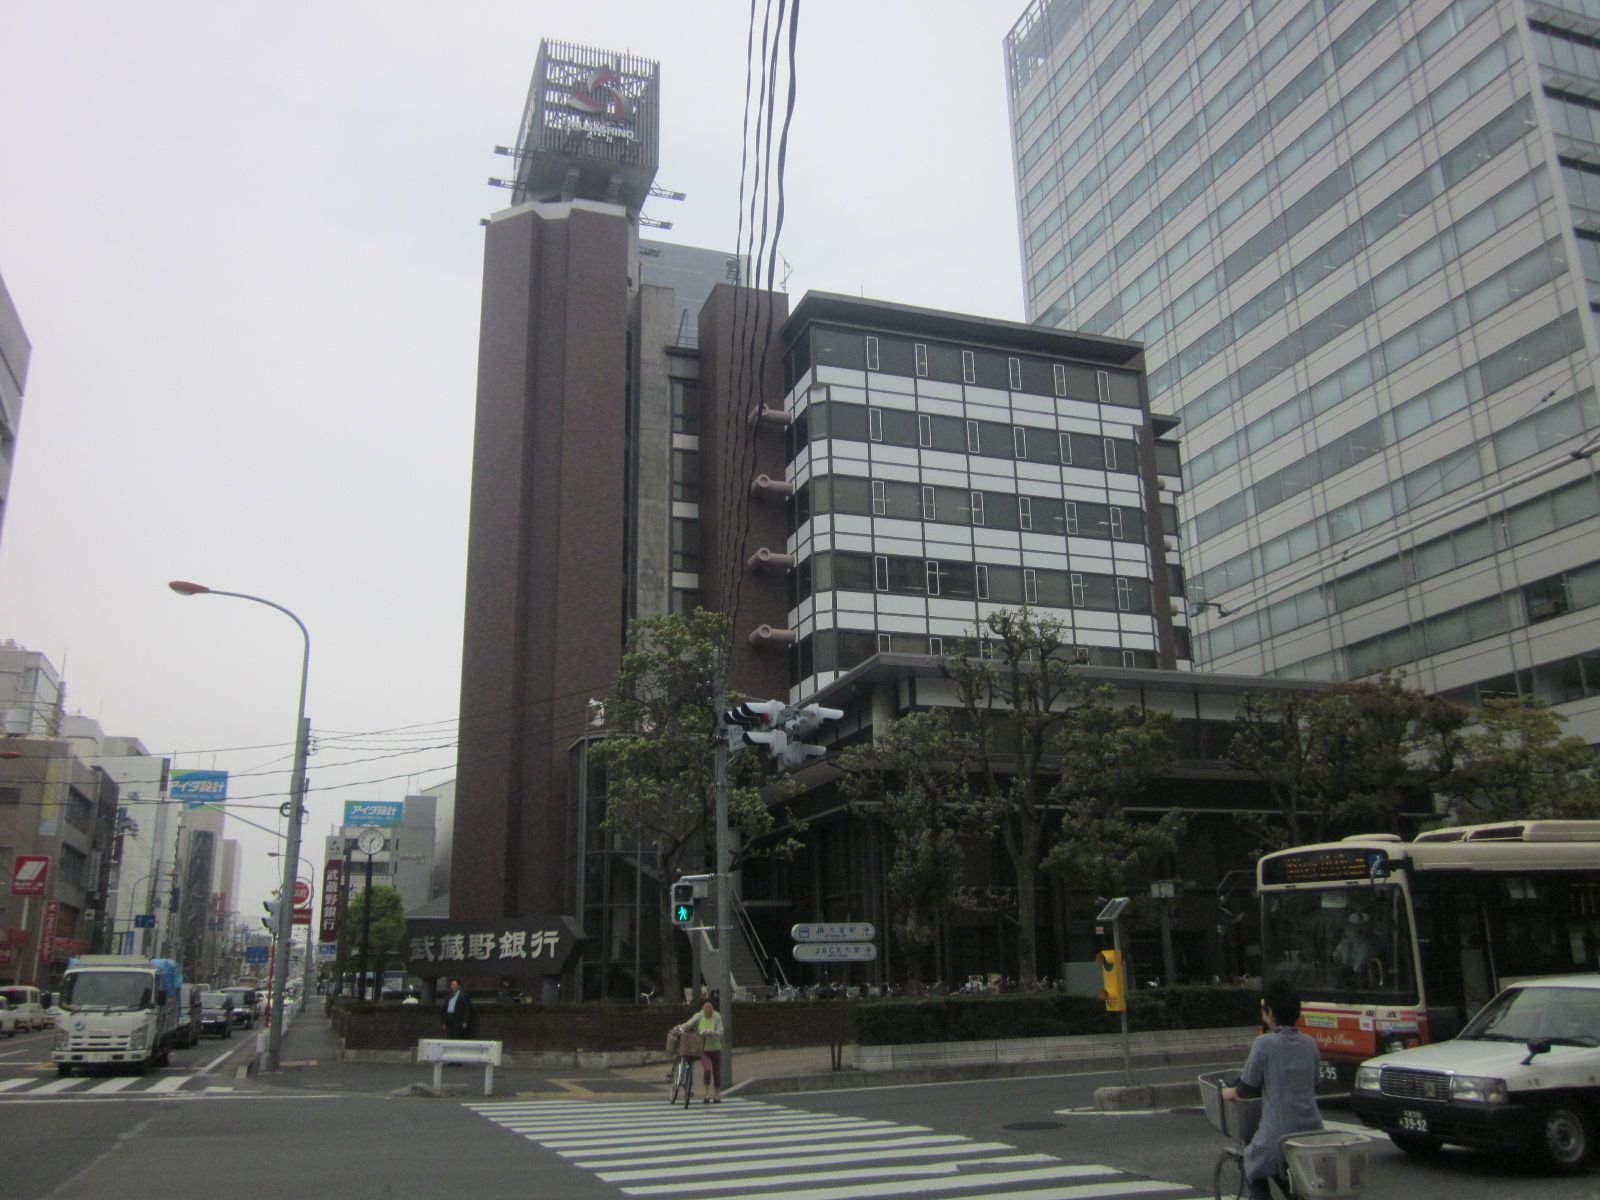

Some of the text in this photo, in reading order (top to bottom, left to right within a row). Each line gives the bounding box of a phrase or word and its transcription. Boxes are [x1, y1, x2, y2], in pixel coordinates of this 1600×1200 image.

[323, 869, 341, 931] 武蔵野銀行
[408, 930, 560, 962] 武蔵野銀行
